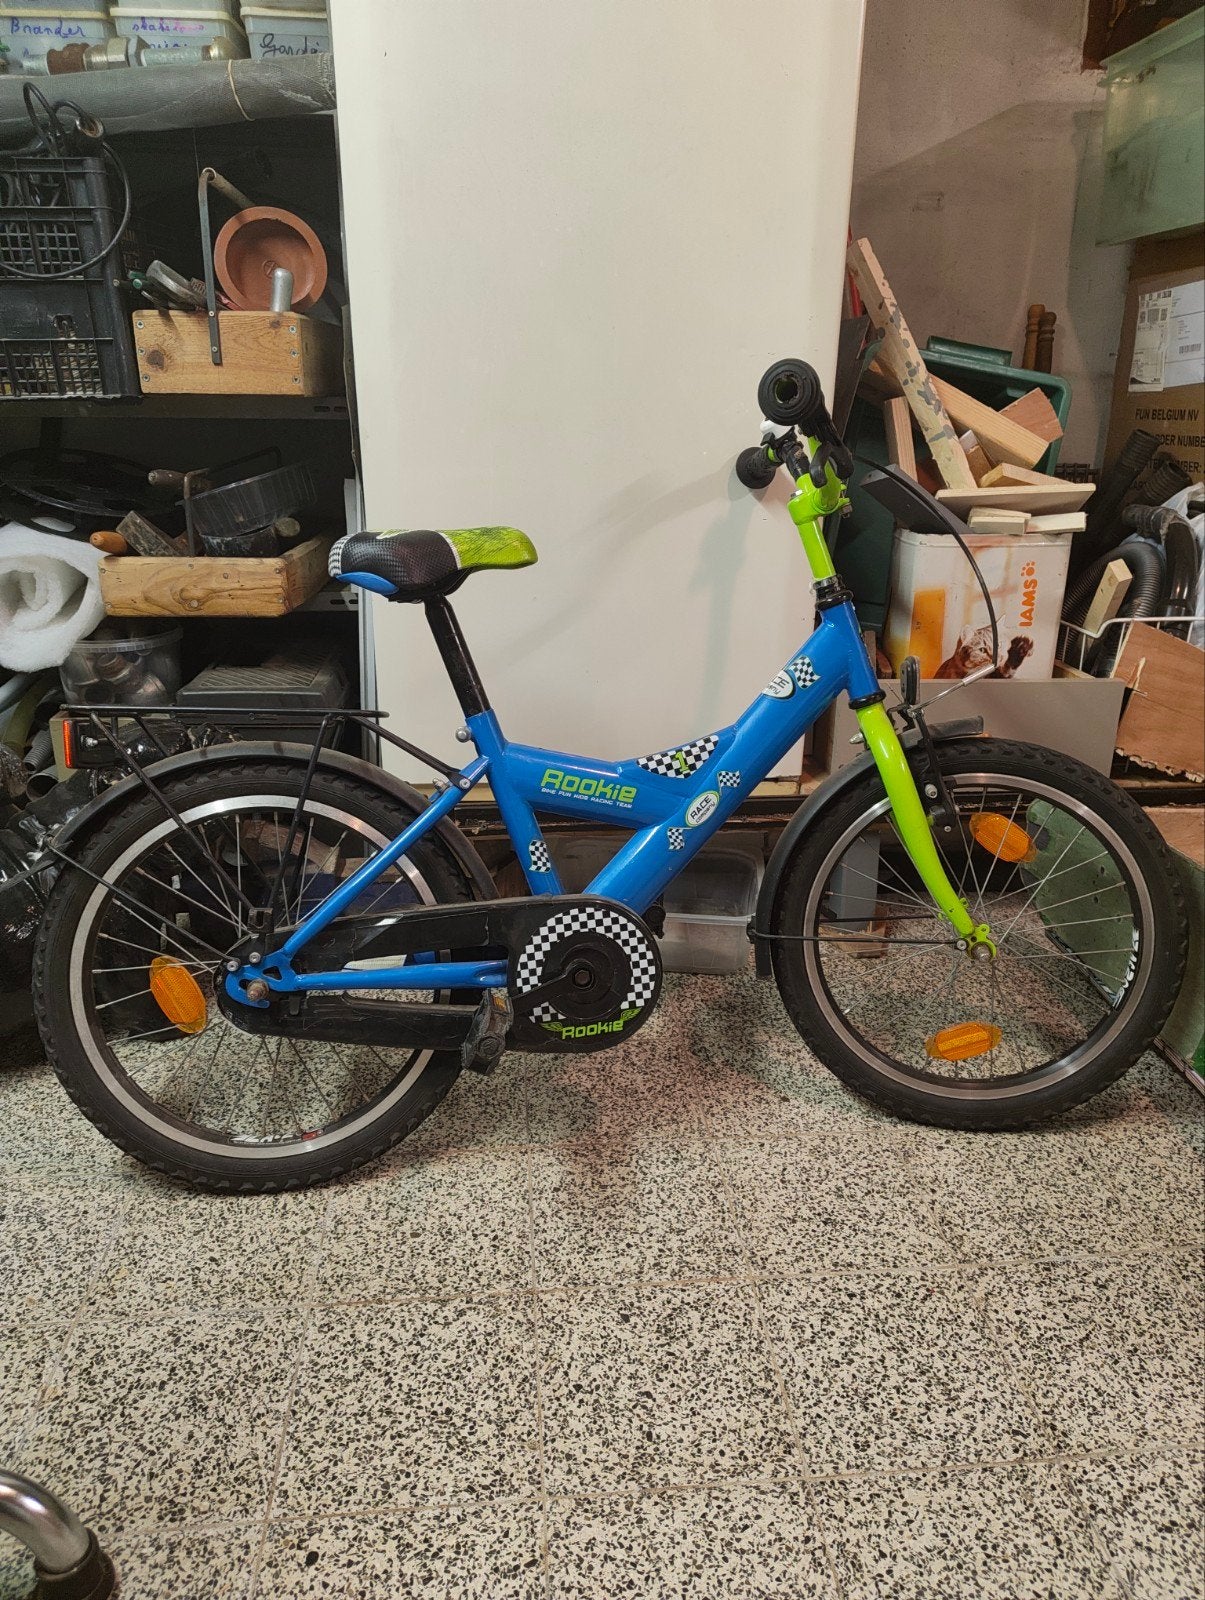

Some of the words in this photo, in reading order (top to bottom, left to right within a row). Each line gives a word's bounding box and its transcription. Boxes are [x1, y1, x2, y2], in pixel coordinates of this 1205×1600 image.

[1135, 408, 1150, 420] FUN
[1151, 408, 1186, 420] BELGIUM
[1187, 409, 1199, 421] NV
[1178, 435, 1205, 447] NUMBE
[1019, 578, 1037, 627] IAMS
[541, 769, 637, 803] Rookie
[541, 787, 556, 795] BIKE
[558, 790, 571, 798] FUN
[590, 796, 613, 805] RACING
[690, 795, 711, 820] RACE
[562, 1019, 624, 1040] Rookie
